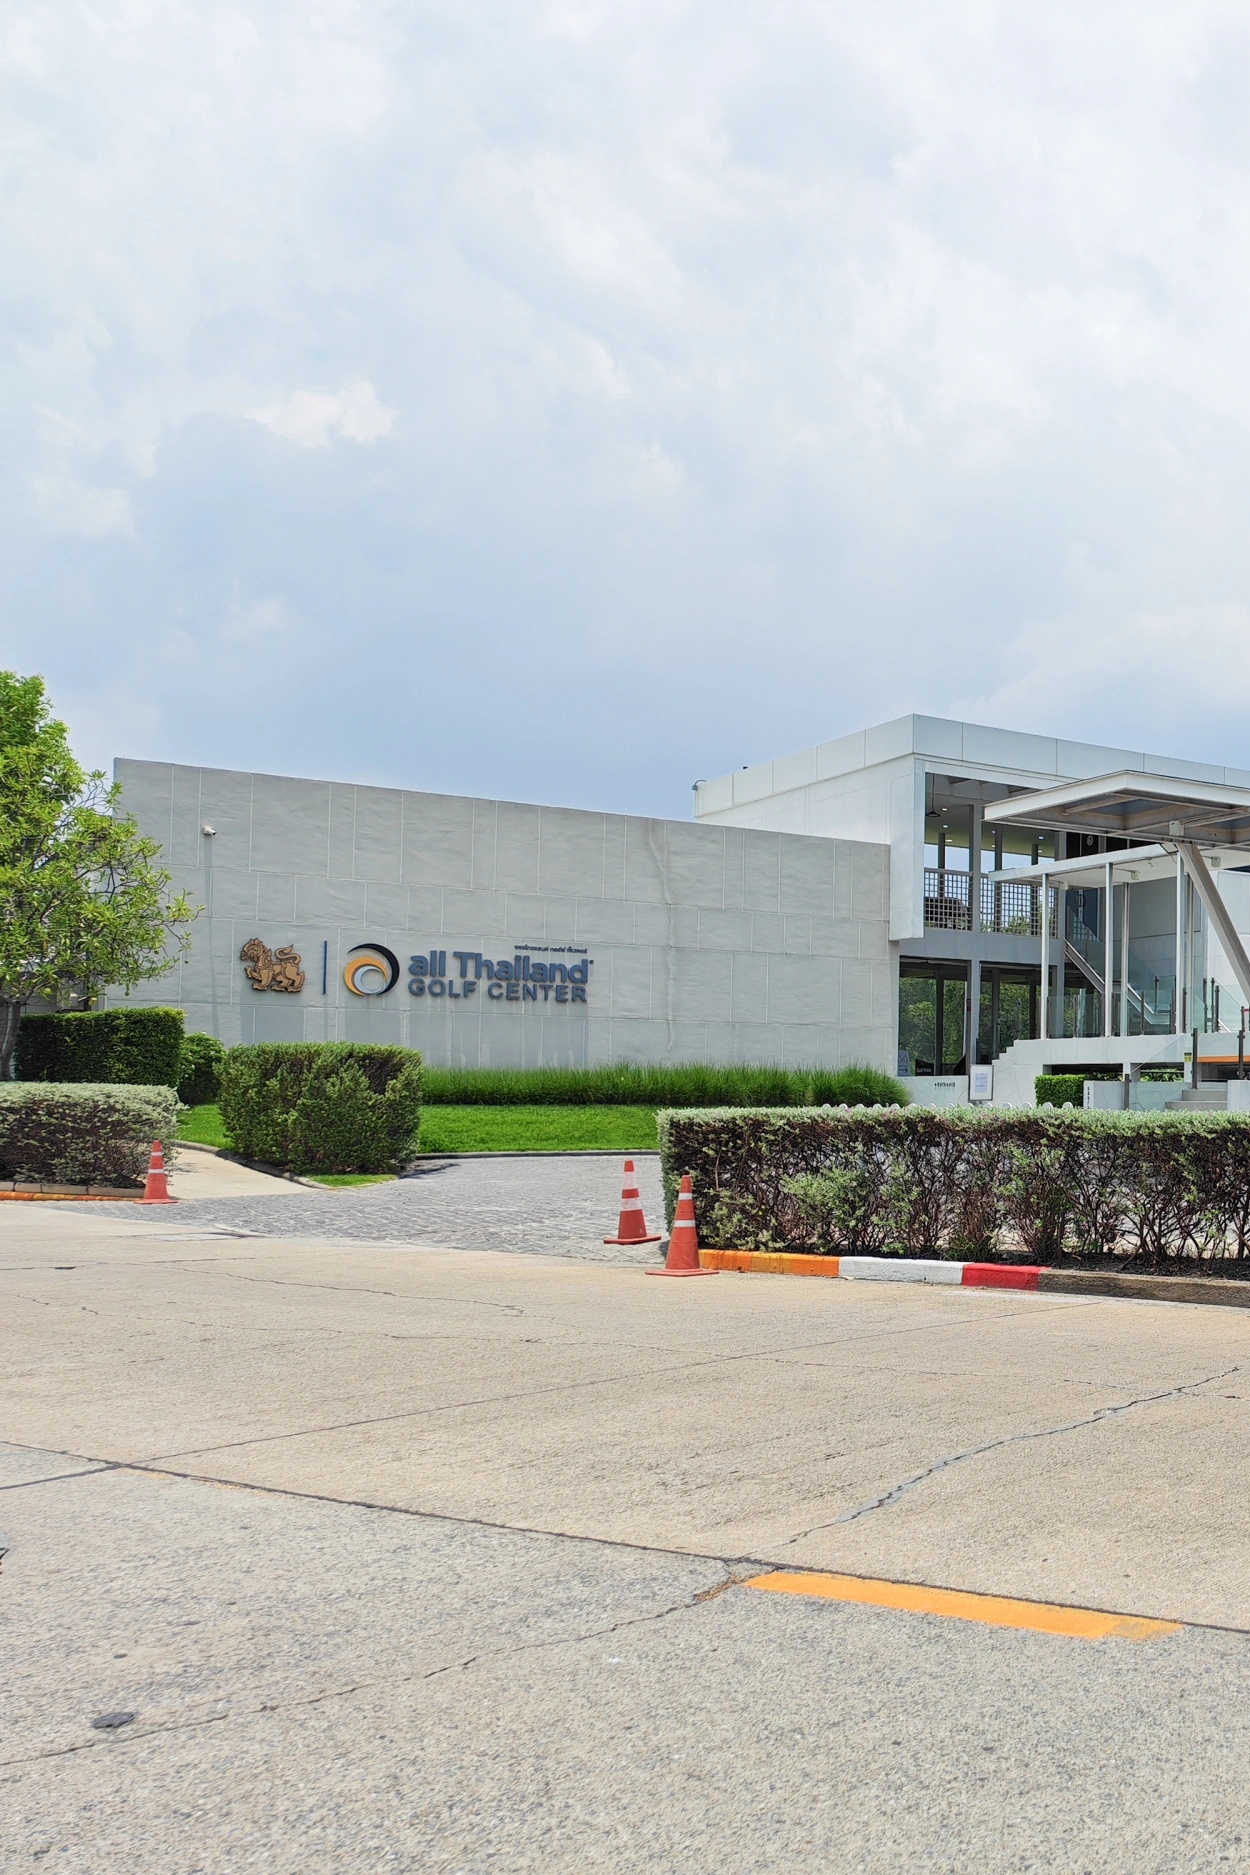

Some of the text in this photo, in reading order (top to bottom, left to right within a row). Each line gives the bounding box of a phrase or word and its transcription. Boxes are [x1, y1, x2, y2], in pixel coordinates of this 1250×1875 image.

[408, 950, 588, 984] all Thailand
[408, 978, 588, 1003] GOLF CENTER
